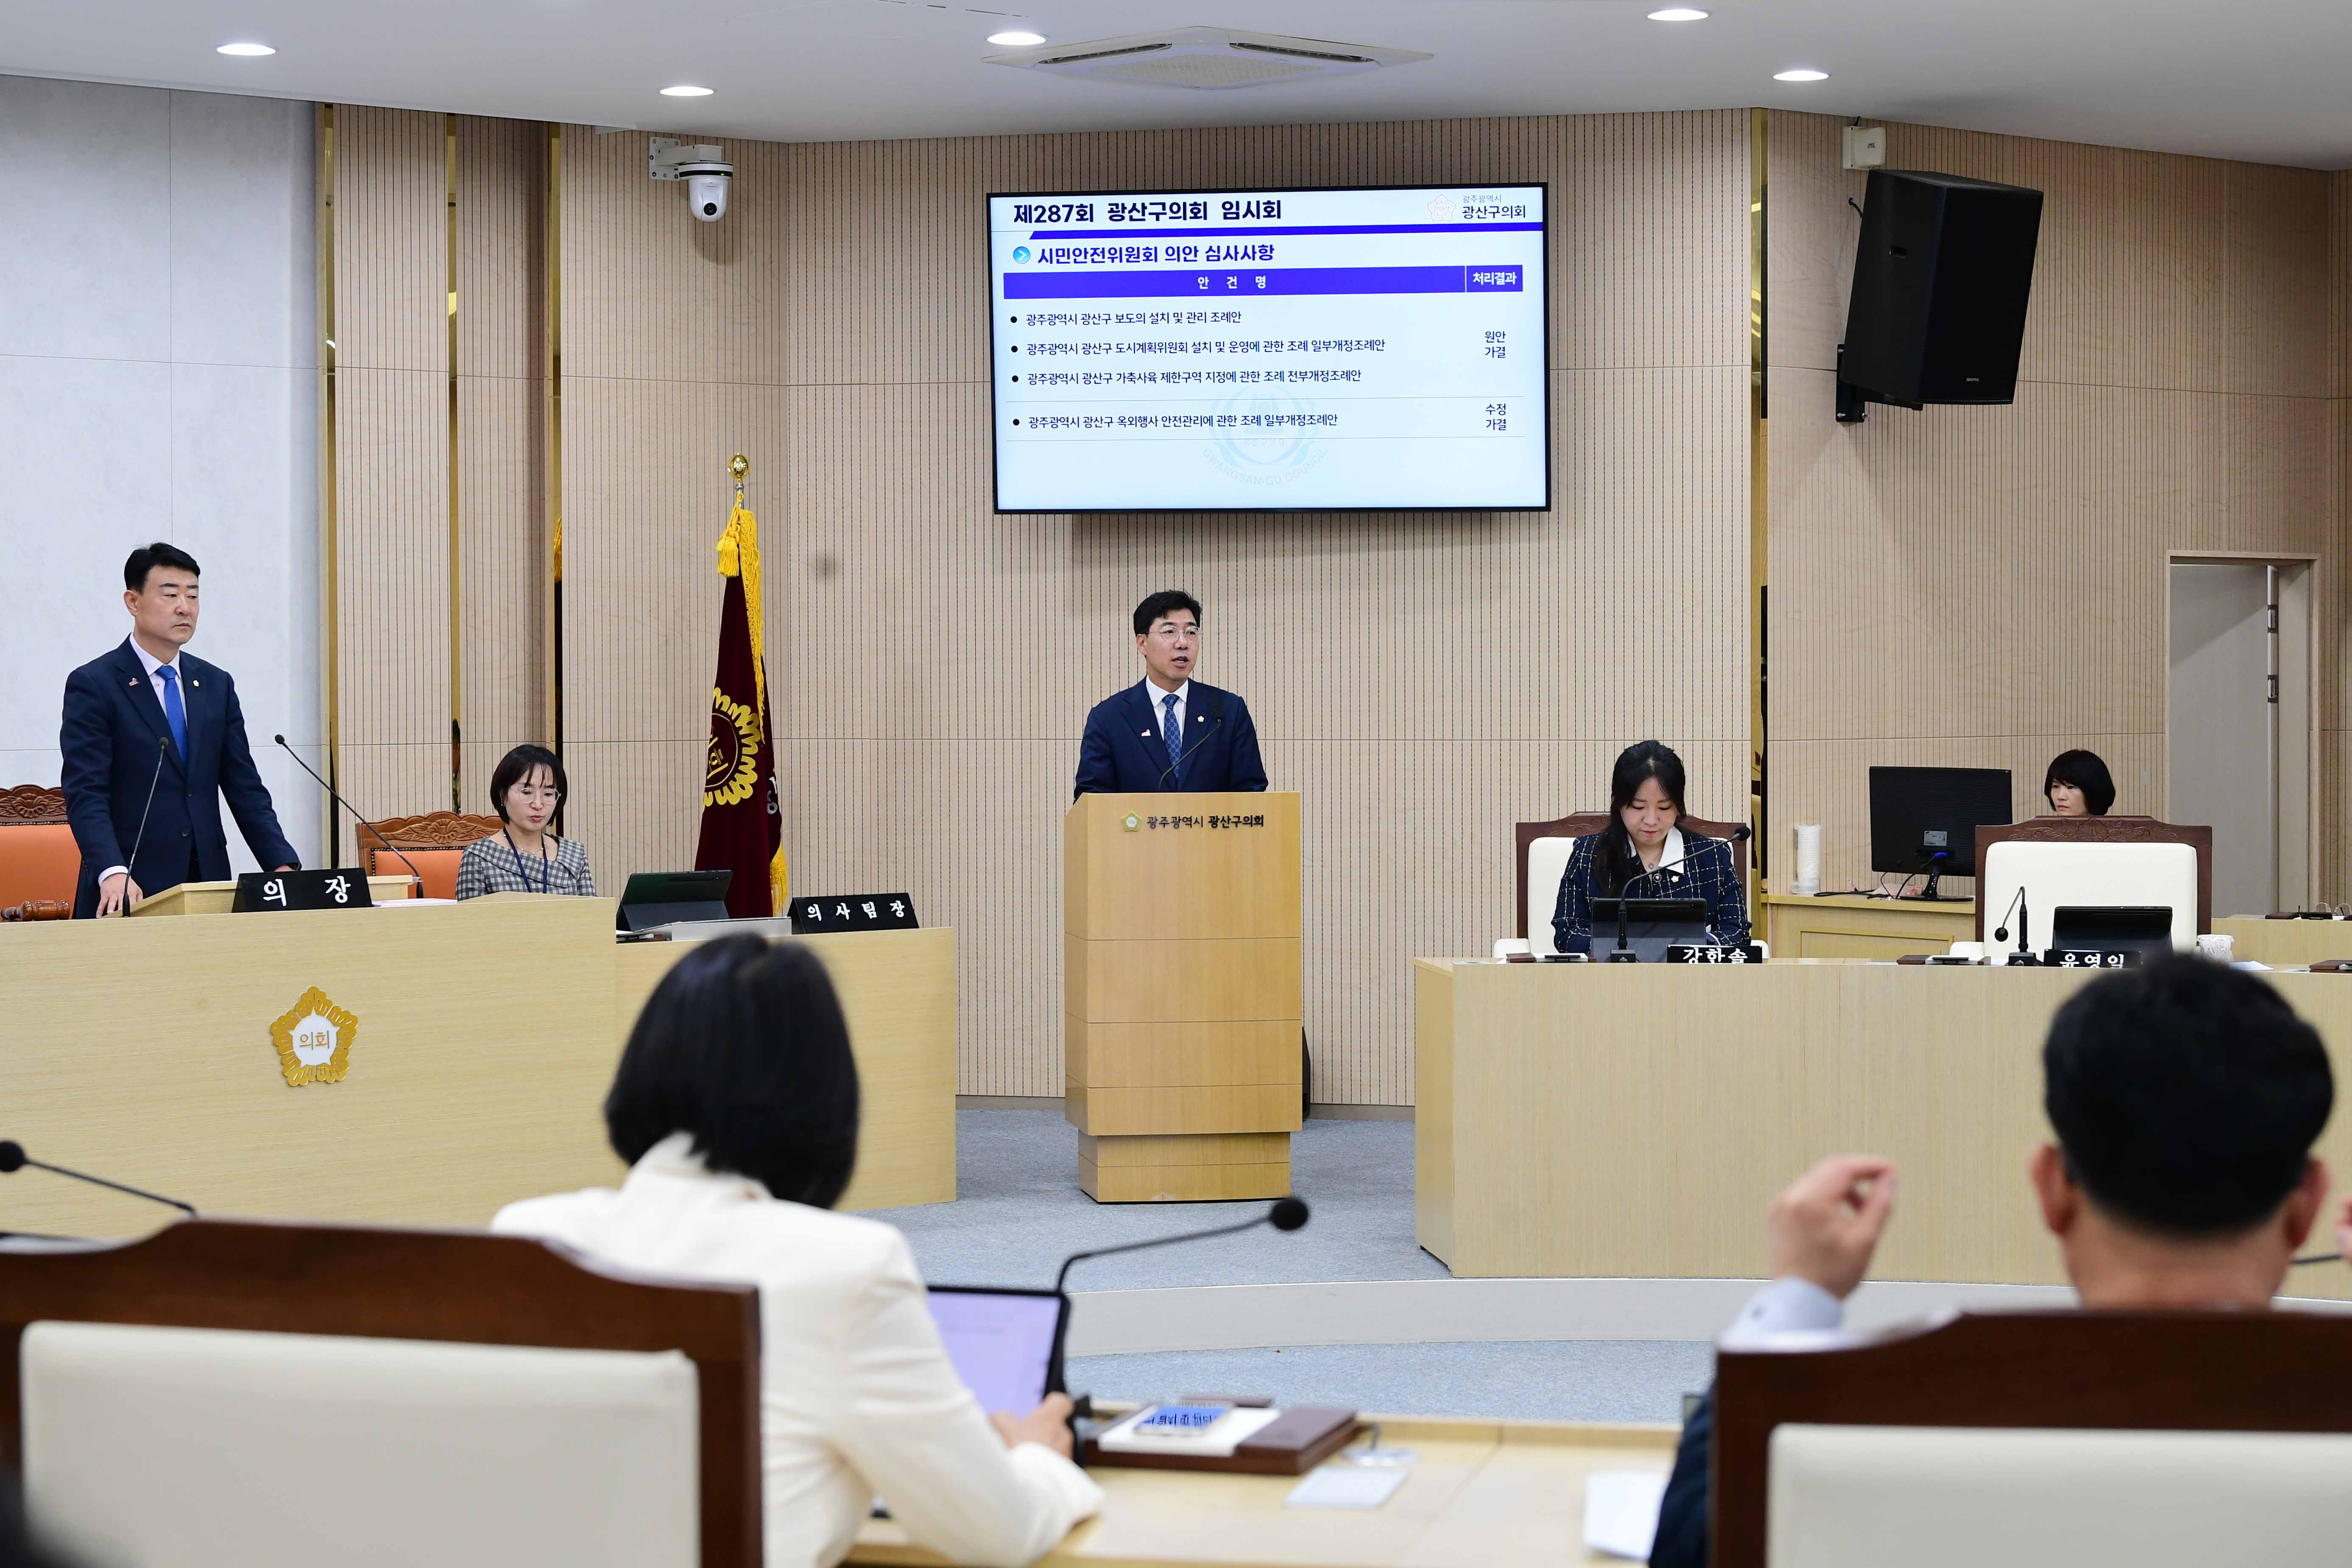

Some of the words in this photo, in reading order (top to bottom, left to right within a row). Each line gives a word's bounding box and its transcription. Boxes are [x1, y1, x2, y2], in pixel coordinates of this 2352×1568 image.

[1463, 194, 1501, 204] 광주광역시
[1014, 203, 1094, 223] 제287회
[1108, 201, 1207, 222] 광산구의회
[1222, 200, 1281, 220] 임시회
[1462, 205, 1525, 219] 광산구의회
[1038, 246, 1158, 264] 시민안전위원회
[1165, 246, 1199, 262] 의안
[1205, 244, 1275, 262] 심사사항
[1473, 271, 1517, 285] 처리결과
[1026, 313, 1077, 326] 광주광역시
[1080, 313, 1112, 326] 광산구
[1115, 312, 1145, 324] 보도의
[1149, 312, 1169, 324] 설치
[1173, 312, 1183, 324] 및
[1186, 312, 1206, 324] 관리
[1210, 311, 1242, 323] 조례안
[1484, 331, 1506, 343] 원안
[1027, 343, 1078, 356] 광주광역시
[1081, 343, 1113, 355] 광산구
[1116, 341, 1188, 354] 도시계획위원회
[1191, 341, 1211, 353] 설치
[1215, 341, 1225, 353] 및
[1228, 340, 1260, 353] 운영에
[1263, 340, 1284, 352] 관한
[1287, 340, 1308, 352] 조례
[1311, 339, 1385, 352] 일부개정조례안
[1485, 346, 1505, 358] 가결
[1027, 373, 1078, 385] 광주광역시
[1082, 372, 1113, 385] 광산구
[1116, 372, 1157, 384] 가축사육
[1161, 371, 1201, 384] 제한구역
[1205, 371, 1236, 383] 지정에
[1239, 371, 1261, 383] 관한
[1264, 371, 1284, 382] 조례
[1288, 369, 1362, 382] 전부개정조례안
[1485, 403, 1506, 416] 수정
[1029, 416, 1080, 429] 광주광역시
[1083, 416, 1114, 428] 광산구
[1117, 416, 1158, 428] 옥외행사
[1161, 415, 1213, 427] 안전관리에
[1216, 415, 1237, 427] 관한
[1240, 414, 1261, 427] 조례
[1264, 414, 1338, 427] 일부개정조례안
[1486, 419, 1506, 431] 가결
[1147, 815, 1203, 829] 광주광역시
[1208, 815, 1264, 829] 광산구의회
[1683, 947, 1748, 964] 강한솔
[299, 1030, 330, 1050] 의회
